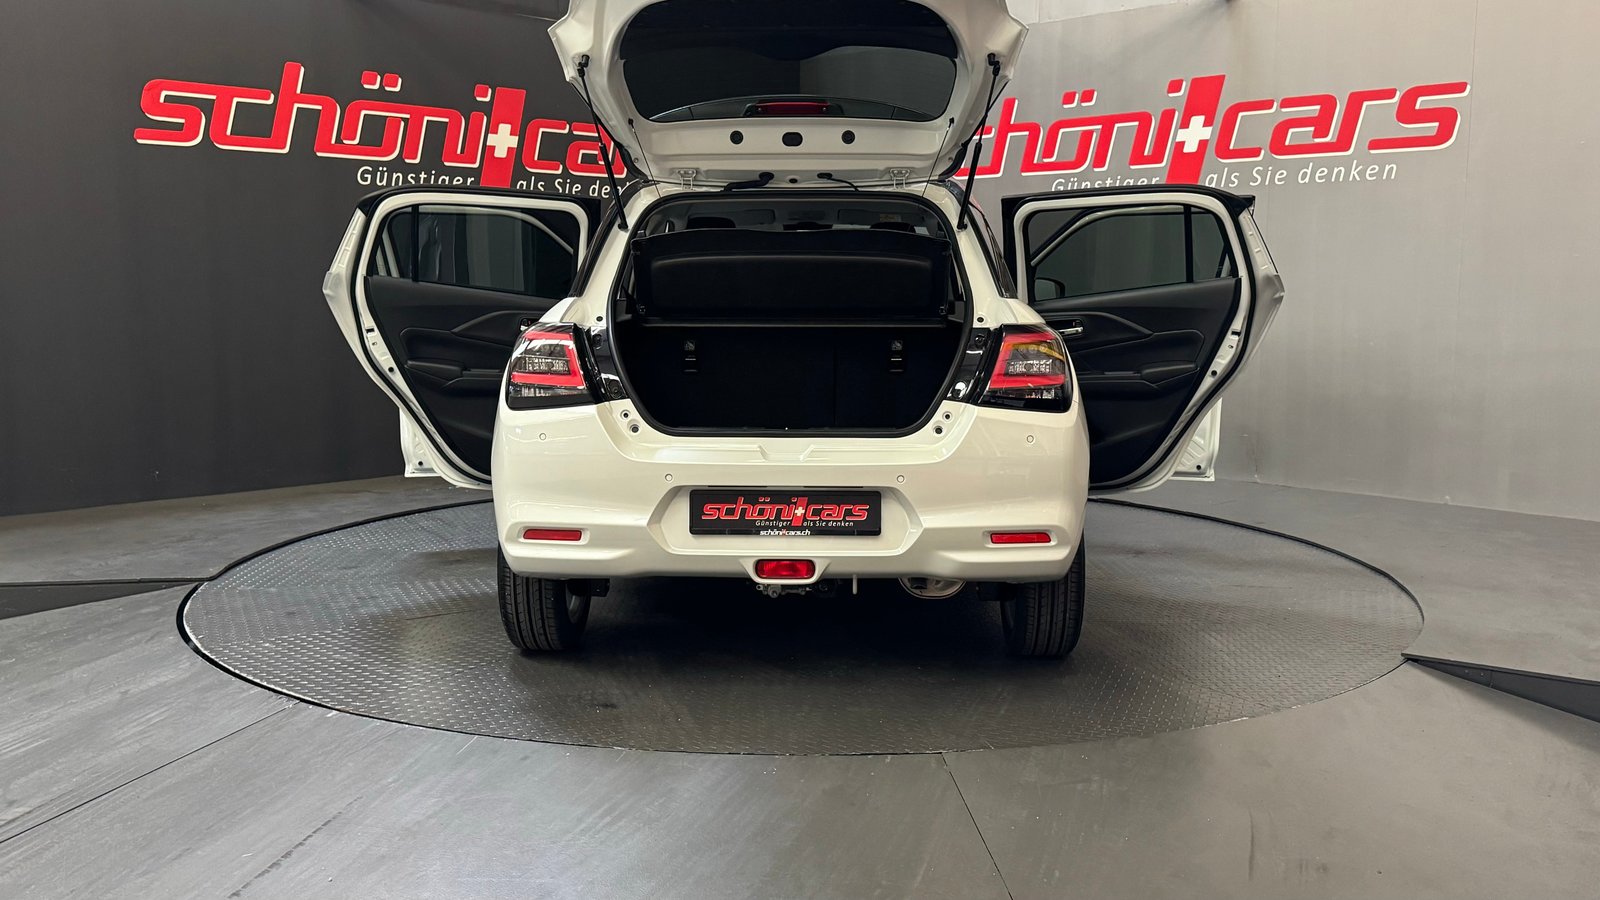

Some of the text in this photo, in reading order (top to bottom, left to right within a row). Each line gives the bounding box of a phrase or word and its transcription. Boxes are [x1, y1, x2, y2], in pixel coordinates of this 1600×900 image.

[522, 118, 628, 178] ca
[554, 178, 582, 195] Sie
[1205, 167, 1240, 188] als
[1249, 166, 1288, 187] Sie
[1297, 159, 1398, 184] denken
